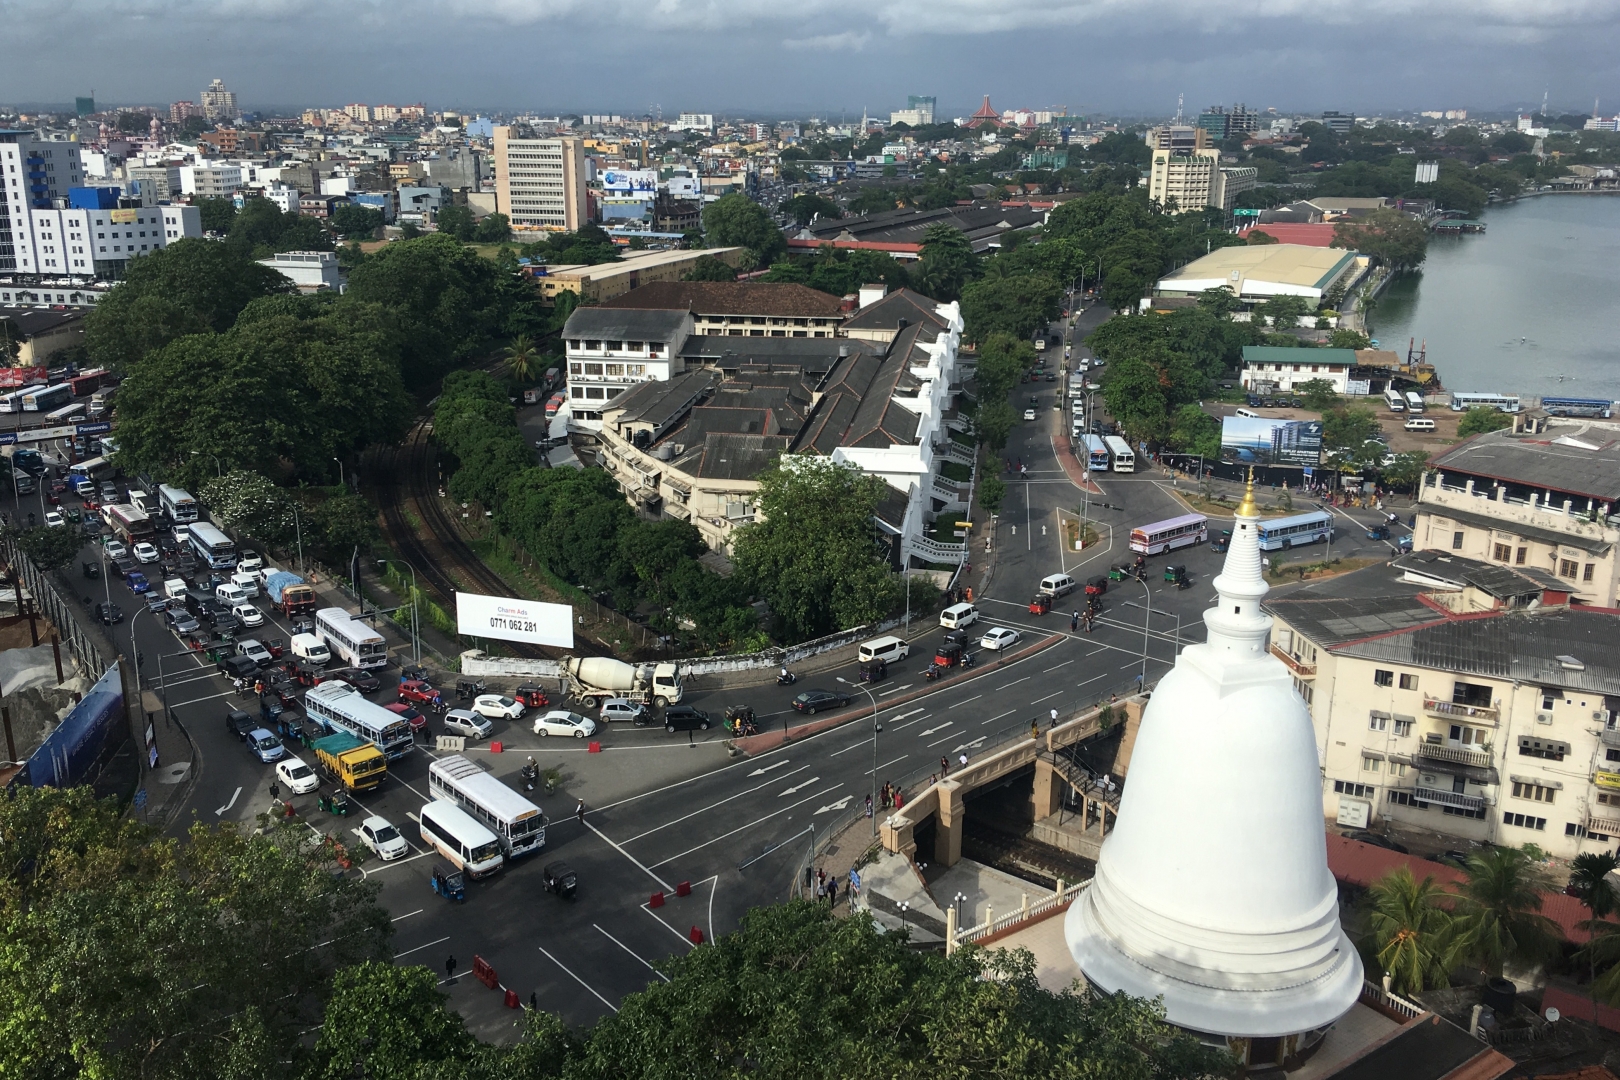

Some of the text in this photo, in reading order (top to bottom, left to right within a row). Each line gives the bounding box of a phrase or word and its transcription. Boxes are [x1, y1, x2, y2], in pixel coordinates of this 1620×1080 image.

[79, 424, 109, 433] Panasonic
[497, 606, 528, 616] Charm Ads
[490, 617, 537, 633] 0771 062 281
